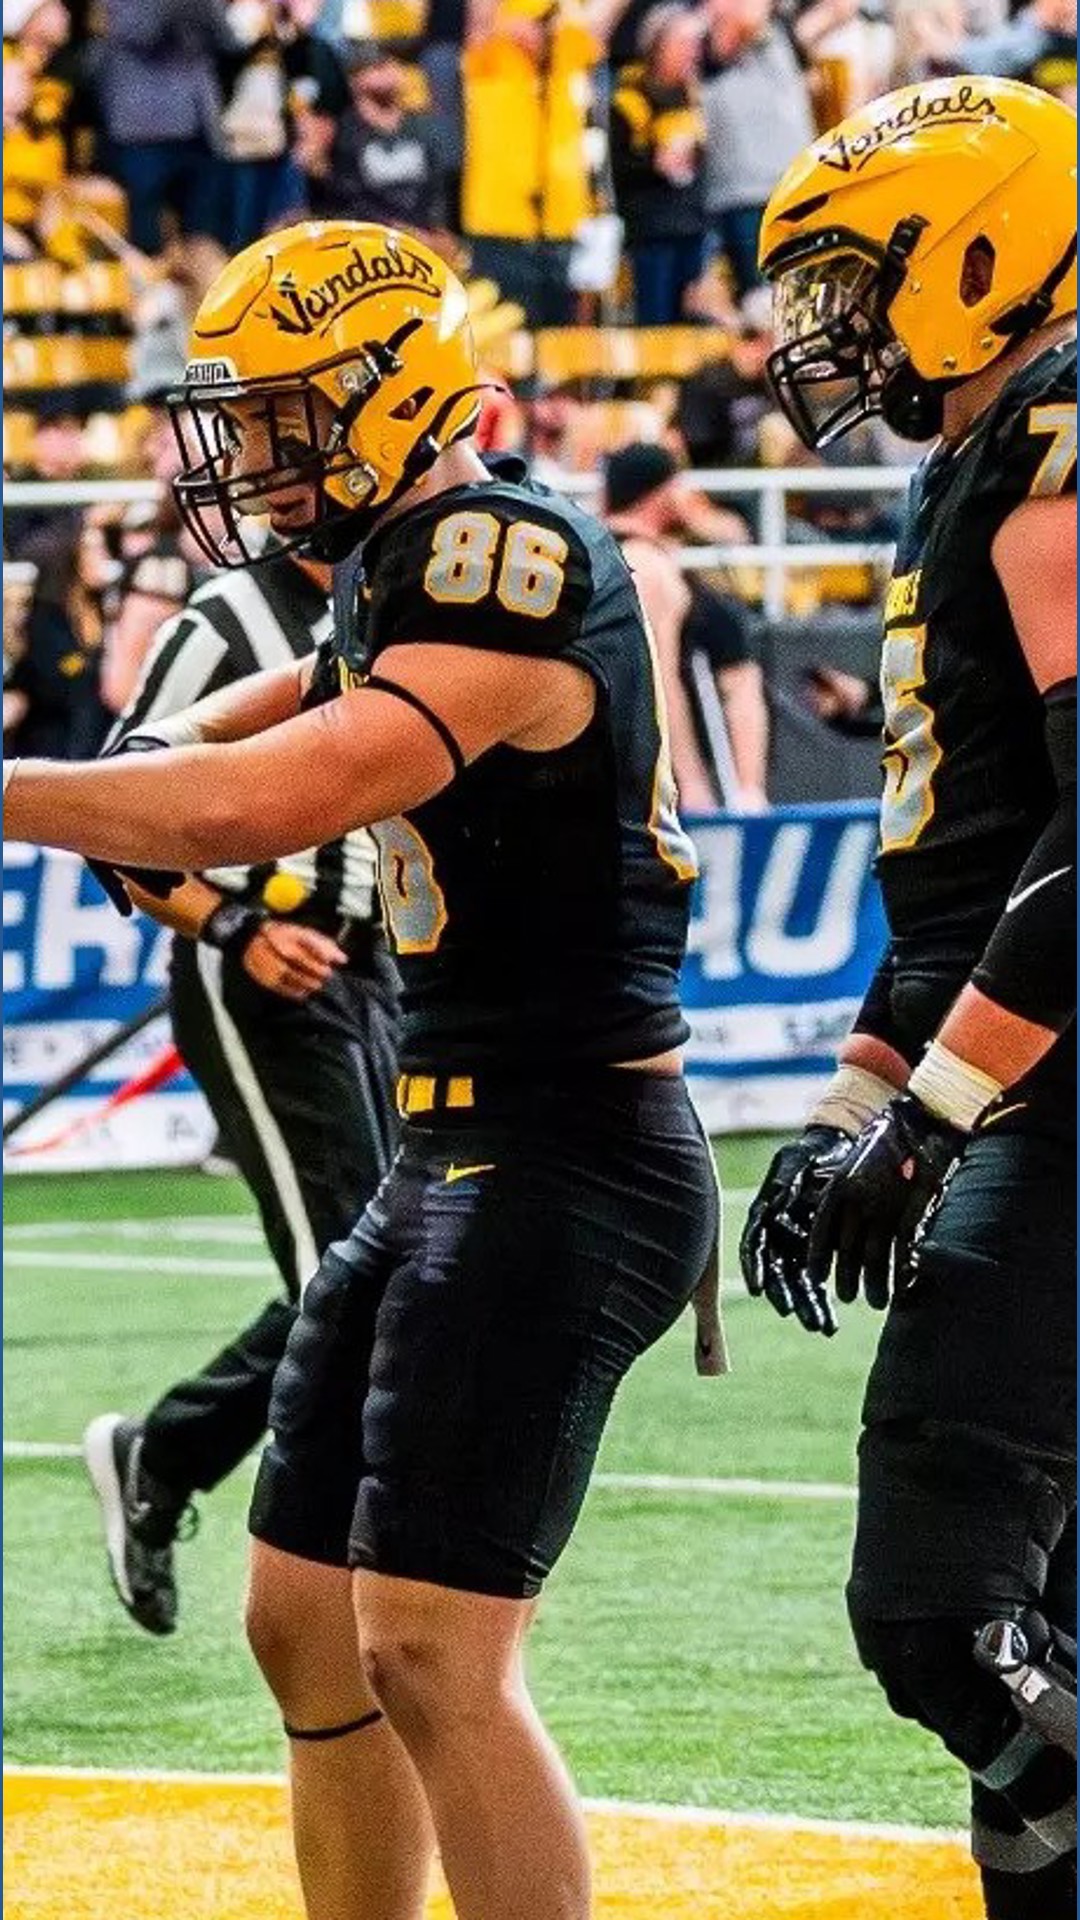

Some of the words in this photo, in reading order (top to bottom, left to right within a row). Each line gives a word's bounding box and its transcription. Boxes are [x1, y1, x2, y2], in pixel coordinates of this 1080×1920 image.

[818, 86, 997, 172] Vandals
[269, 242, 433, 336] Vandals
[424, 511, 569, 618] 86
